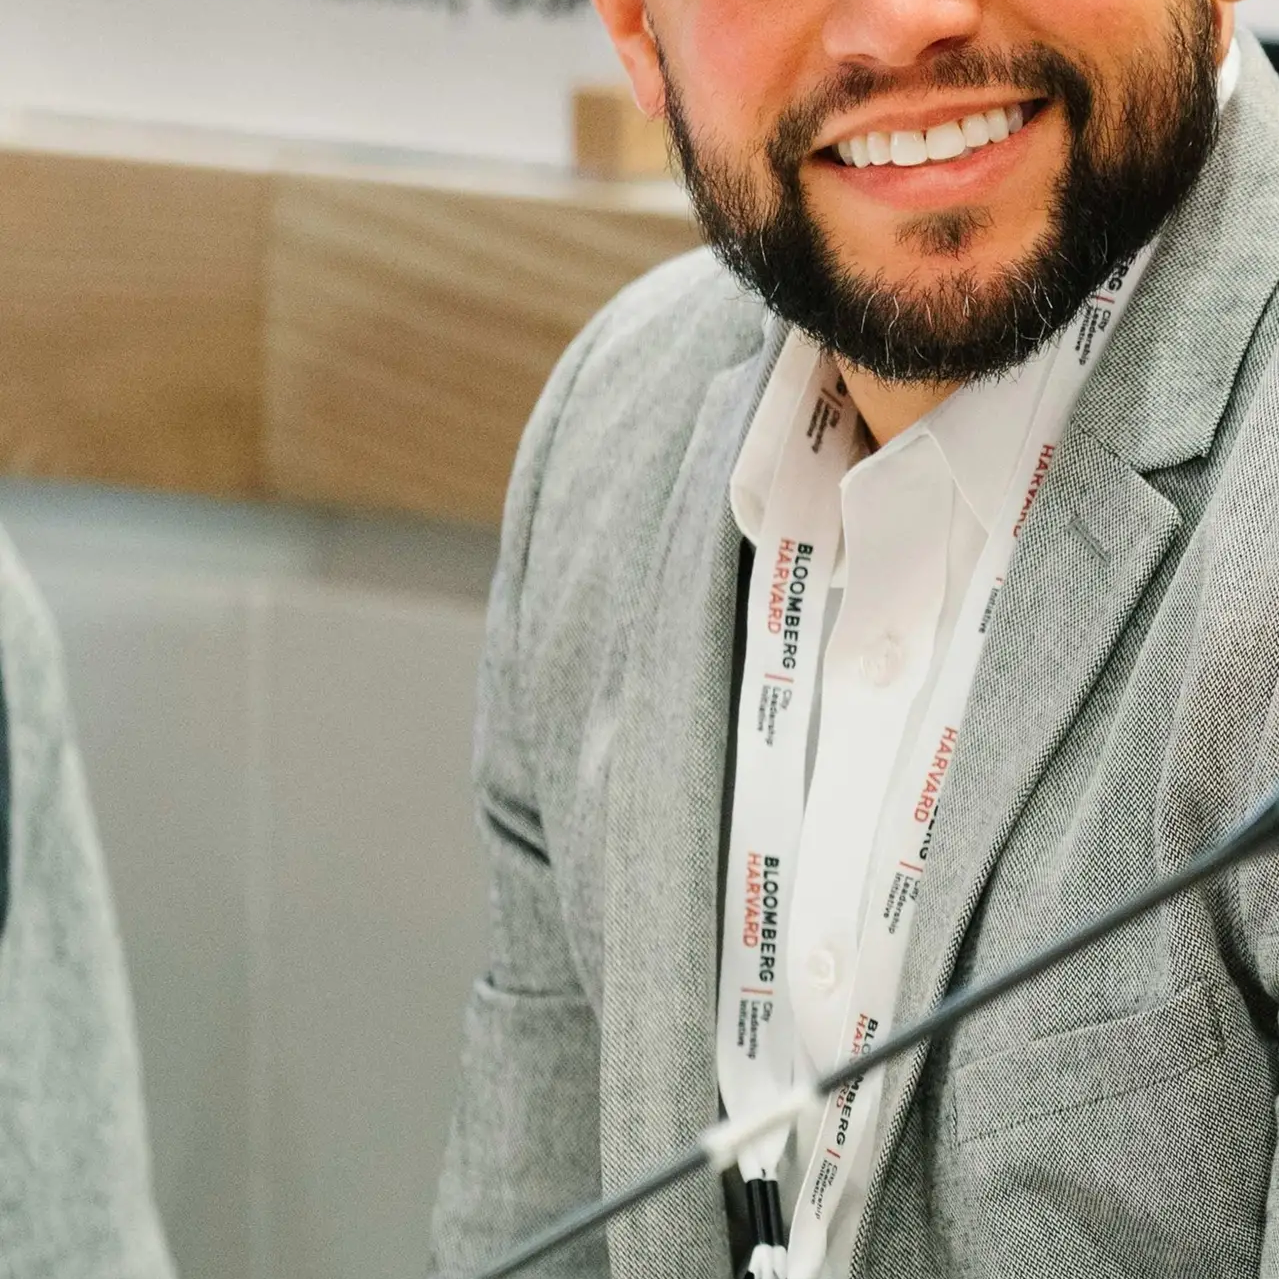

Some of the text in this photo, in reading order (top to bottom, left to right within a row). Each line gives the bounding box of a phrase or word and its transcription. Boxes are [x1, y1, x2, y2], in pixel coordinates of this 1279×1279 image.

[767, 537, 796, 635] HARVARD
[782, 541, 813, 670] BLOOMBERG
[780, 689, 793, 711] City
[914, 726, 958, 823] HARVARD
[743, 852, 762, 948] HARVARD
[759, 854, 779, 983] BLOOMBERG
[883, 872, 902, 919] Initiative
[888, 876, 914, 935] Leadership
[836, 1013, 869, 1109] HARRD
[836, 1018, 878, 1146] BLOMBERG
[811, 1159, 828, 1206] Initiative
[828, 1164, 838, 1187] City
